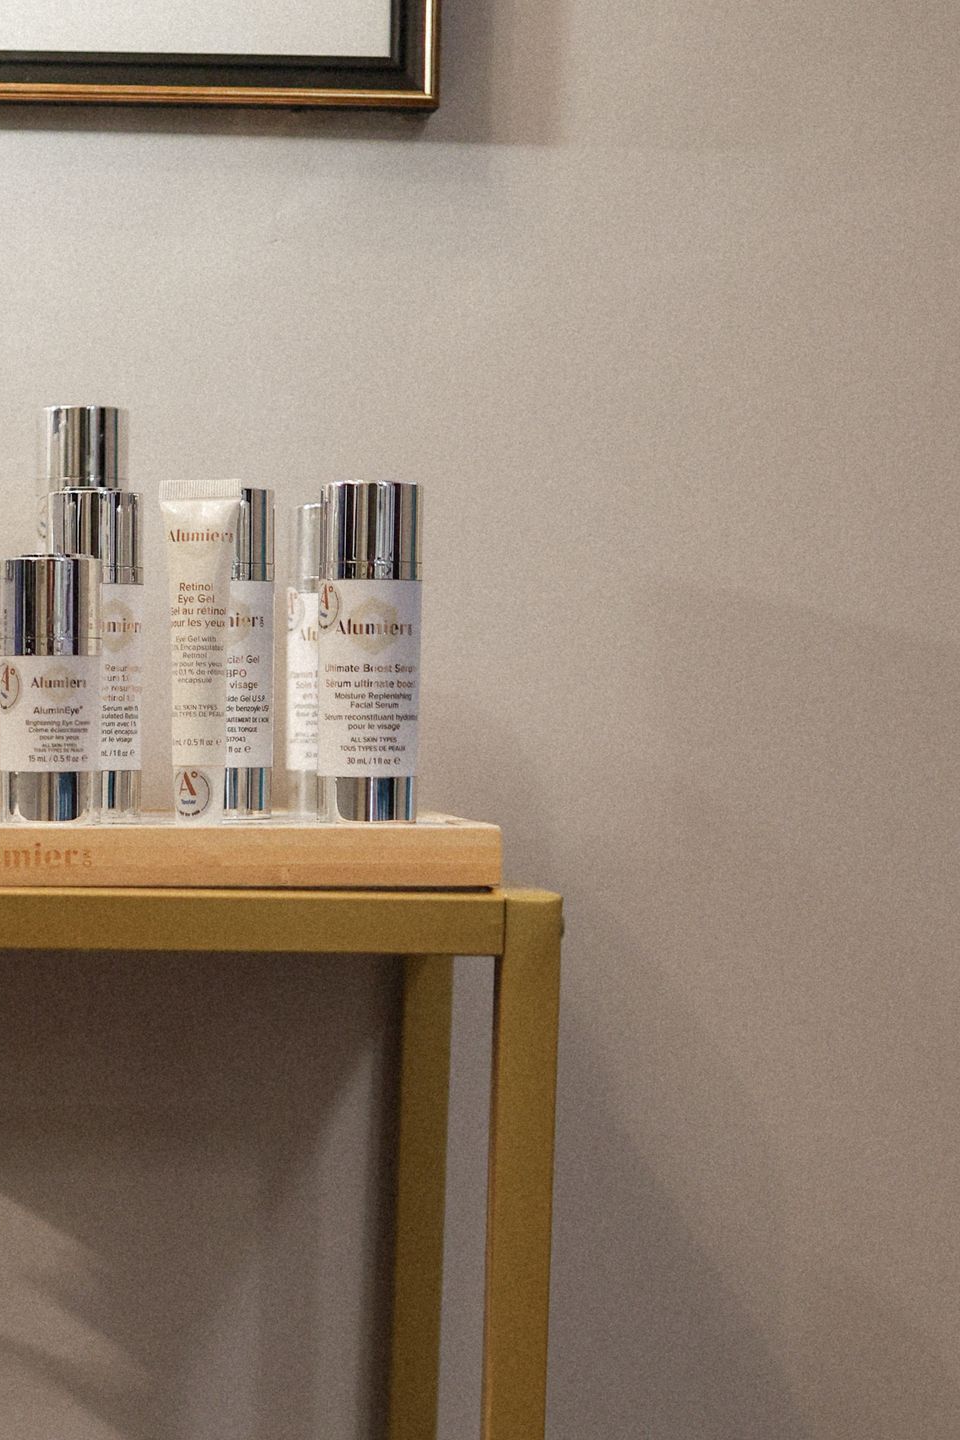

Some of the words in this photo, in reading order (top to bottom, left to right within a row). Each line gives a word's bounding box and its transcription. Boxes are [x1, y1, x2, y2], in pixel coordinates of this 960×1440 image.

[168, 527, 228, 544] Alumier
[179, 583, 213, 591] Retinol
[178, 594, 194, 604] Eye
[197, 594, 214, 603] Gel
[182, 607, 193, 616] au
[187, 620, 201, 628] les
[205, 620, 225, 628] yeux
[336, 618, 408, 636] Alumier
[246, 655, 259, 663] Gel
[325, 663, 359, 673] Ultimate
[363, 663, 392, 673] Boost
[31, 677, 83, 688] Alumier
[229, 681, 258, 690] visage
[355, 678, 394, 688] ultimate
[334, 692, 366, 700] Moisture
[368, 692, 412, 700] Replenishing
[236, 705, 261, 714] benzoyle
[348, 723, 366, 731] pour
[368, 723, 375, 731] le
[377, 723, 400, 731] visage
